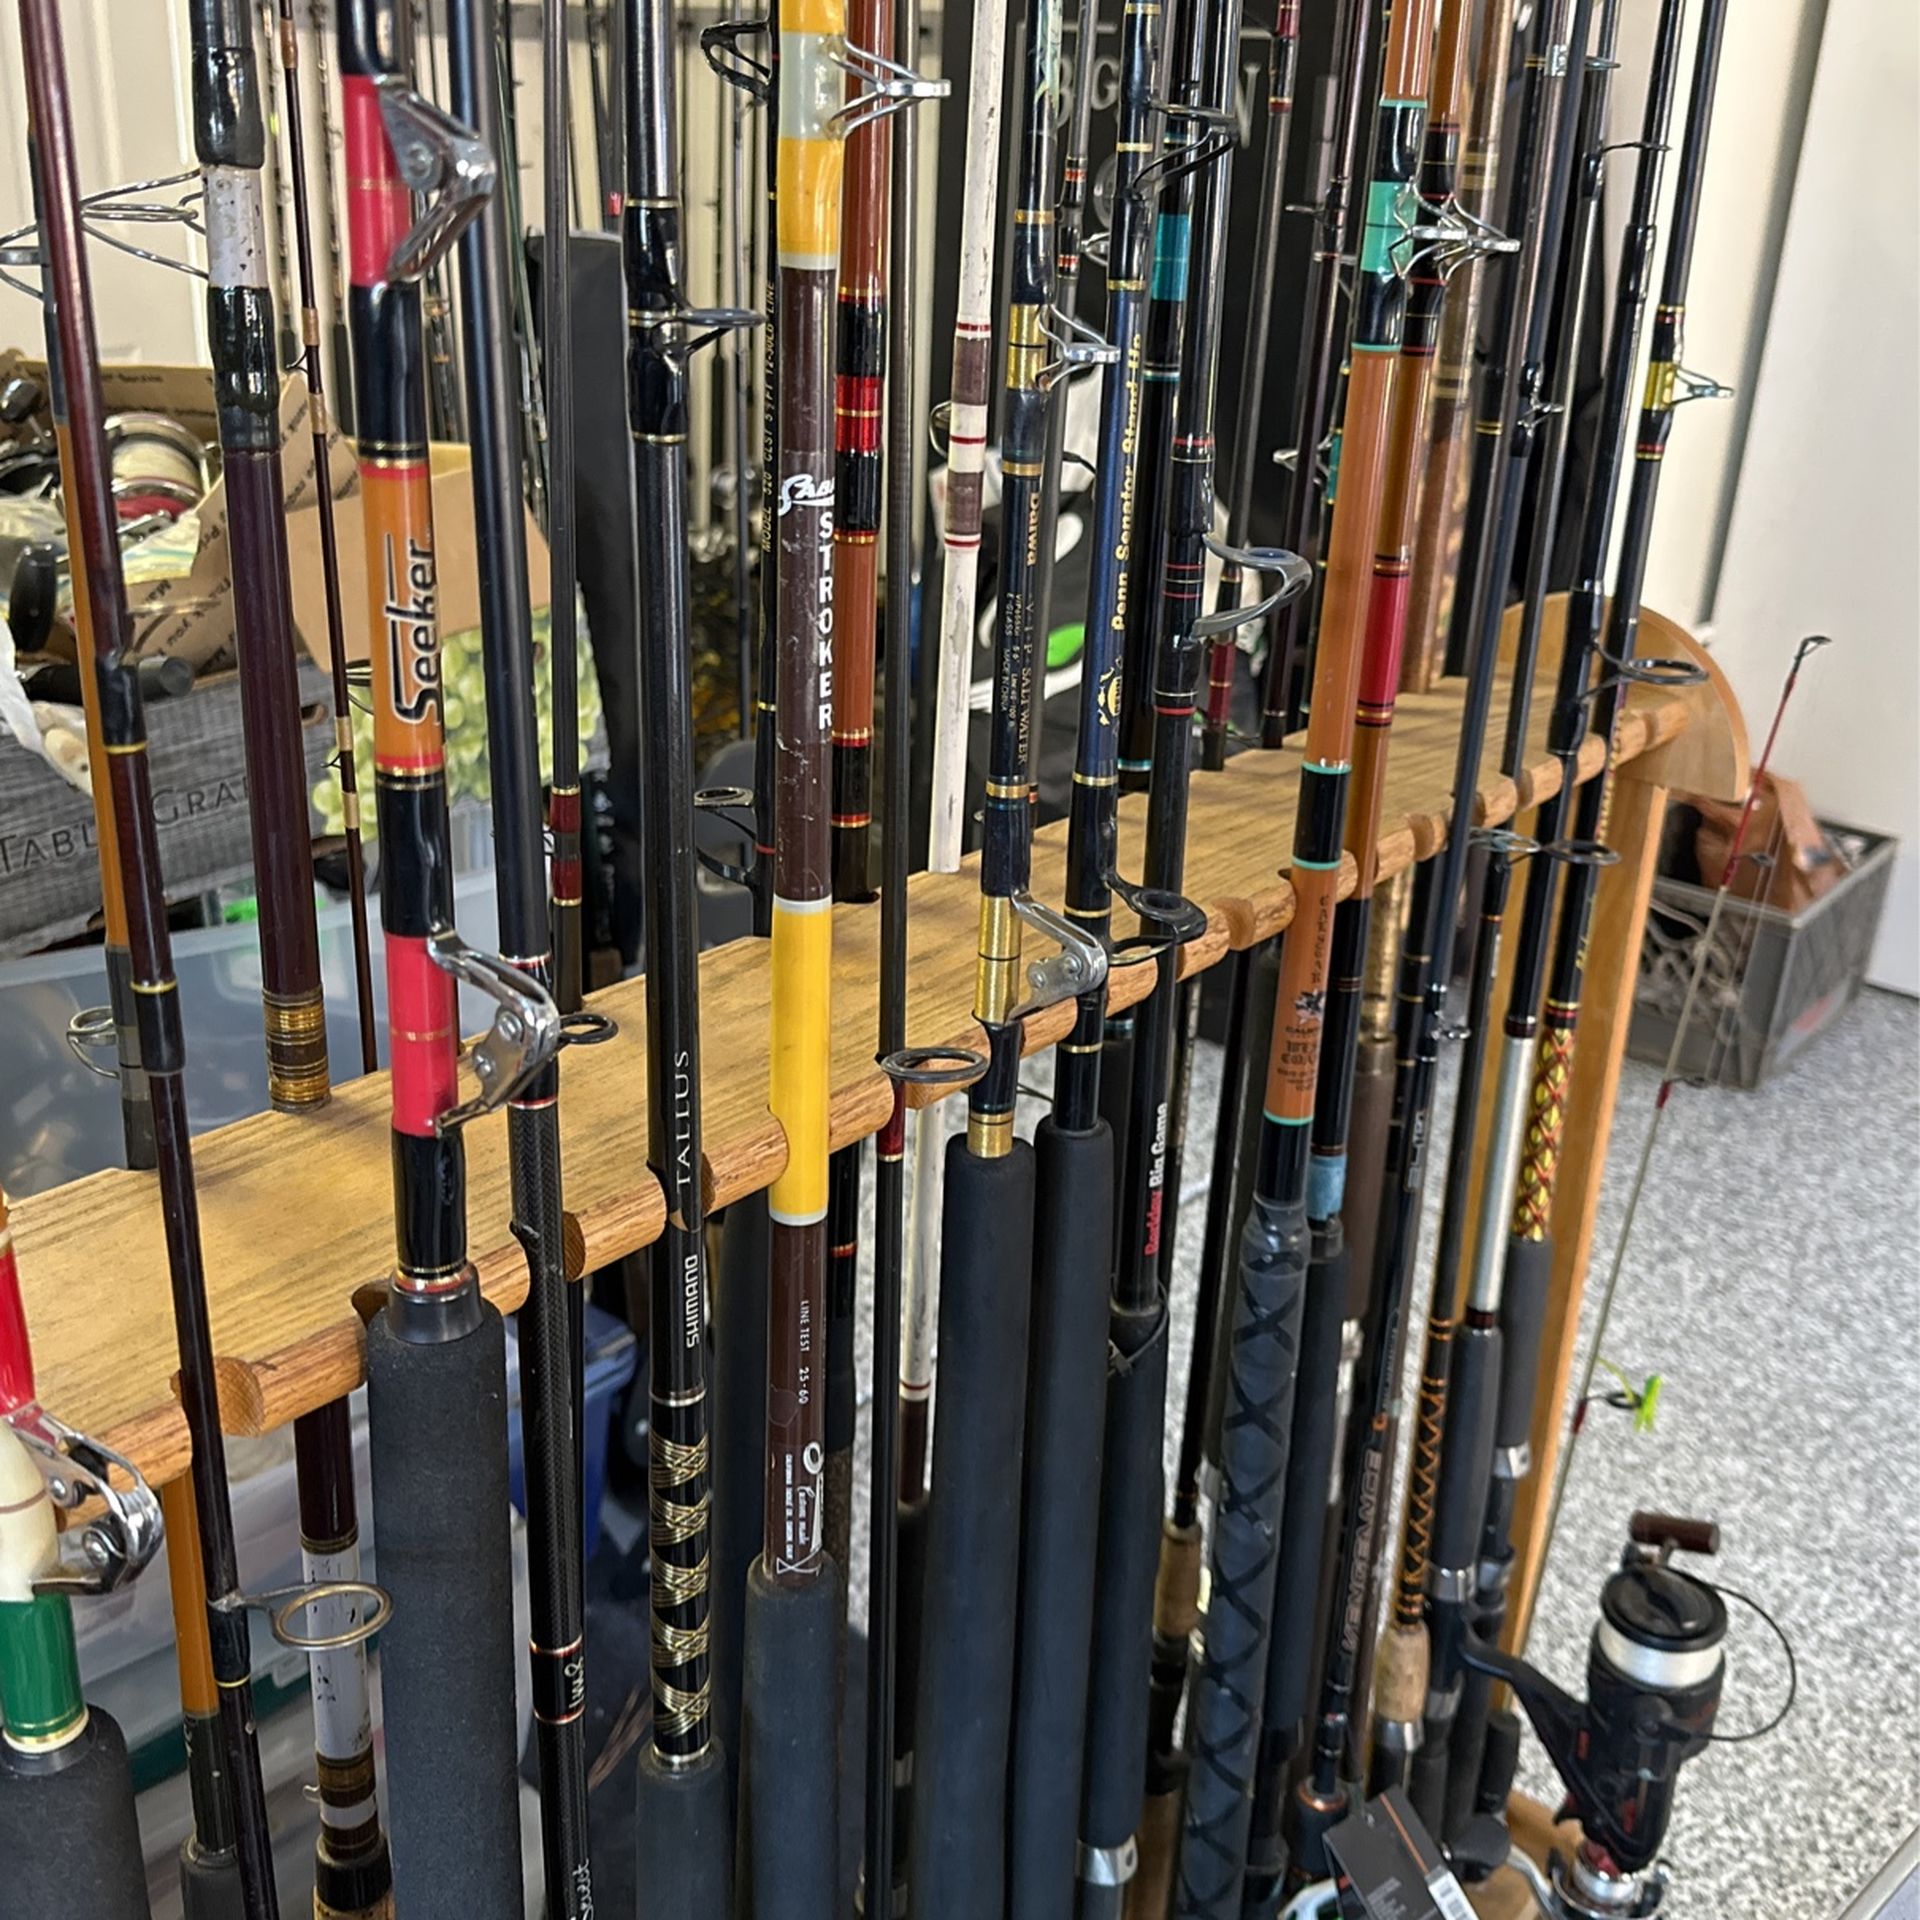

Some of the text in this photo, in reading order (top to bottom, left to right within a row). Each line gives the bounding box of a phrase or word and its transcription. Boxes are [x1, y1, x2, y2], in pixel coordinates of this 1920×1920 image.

[1027, 492, 1039, 566] Daiwa
[1115, 465, 1133, 561] Senator
[384, 533, 441, 726] Seeker
[819, 510, 834, 730] STROKER
[1111, 572, 1128, 631] Penn
[674, 1051, 691, 1196] TALLUS
[1151, 1102, 1168, 1156] Game
[684, 1254, 700, 1349] SHIMANO
[800, 1300, 810, 1325] LINE
[800, 1327, 810, 1352] TEST
